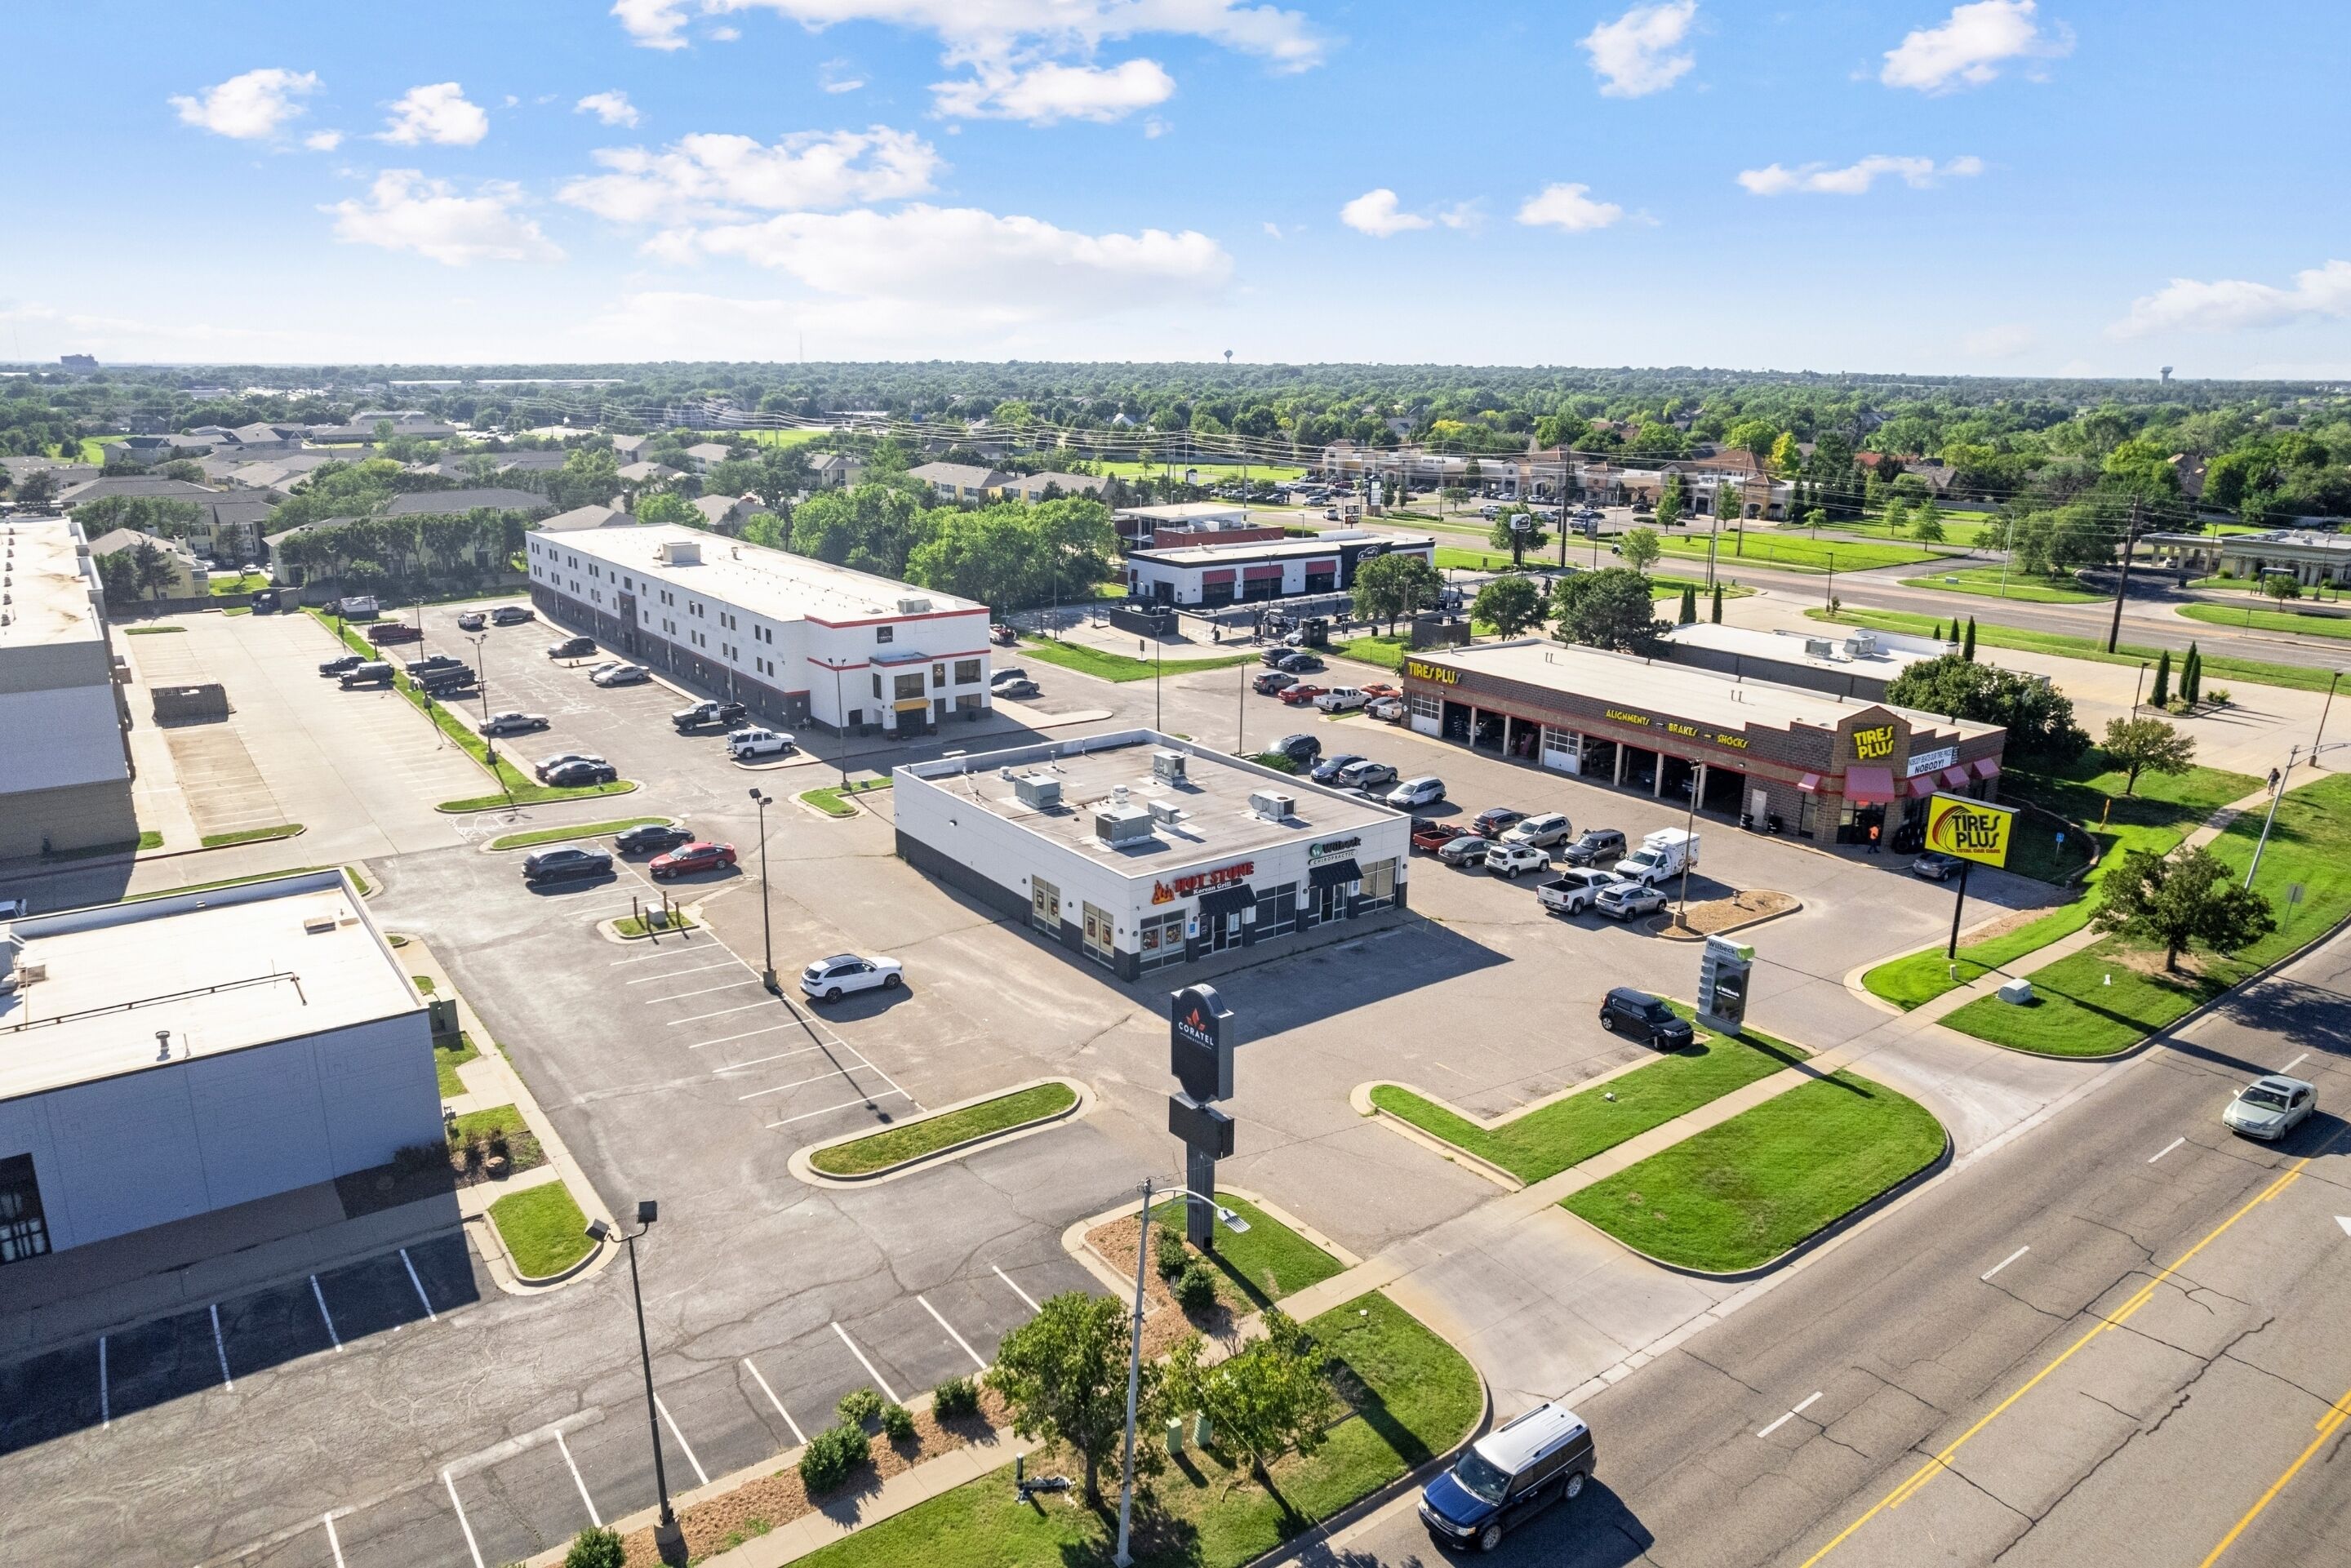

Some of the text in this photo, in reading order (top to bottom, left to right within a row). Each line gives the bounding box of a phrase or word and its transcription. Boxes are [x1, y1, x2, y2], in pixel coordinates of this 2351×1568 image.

[1408, 661, 1462, 685] TIRES PLUS
[1606, 709, 1650, 726] ALIGNMENTS
[1669, 722, 1698, 737] BRAKES
[1718, 734, 1749, 748] SHOCKS
[1854, 726, 1893, 746] TIRES
[1858, 740, 1894, 759] PLUS
[1914, 759, 1944, 774] NOBODY!
[1952, 815, 2001, 832] TIRES
[1956, 832, 2000, 848] PLUS
[1313, 851, 1354, 864] CHIROPRACTIC
[1175, 861, 1255, 893] HOT STONE
[1193, 886, 1215, 895] Korean
[1708, 939, 1736, 954] Wilbeck
[1178, 1021, 1214, 1046] CORATEL
